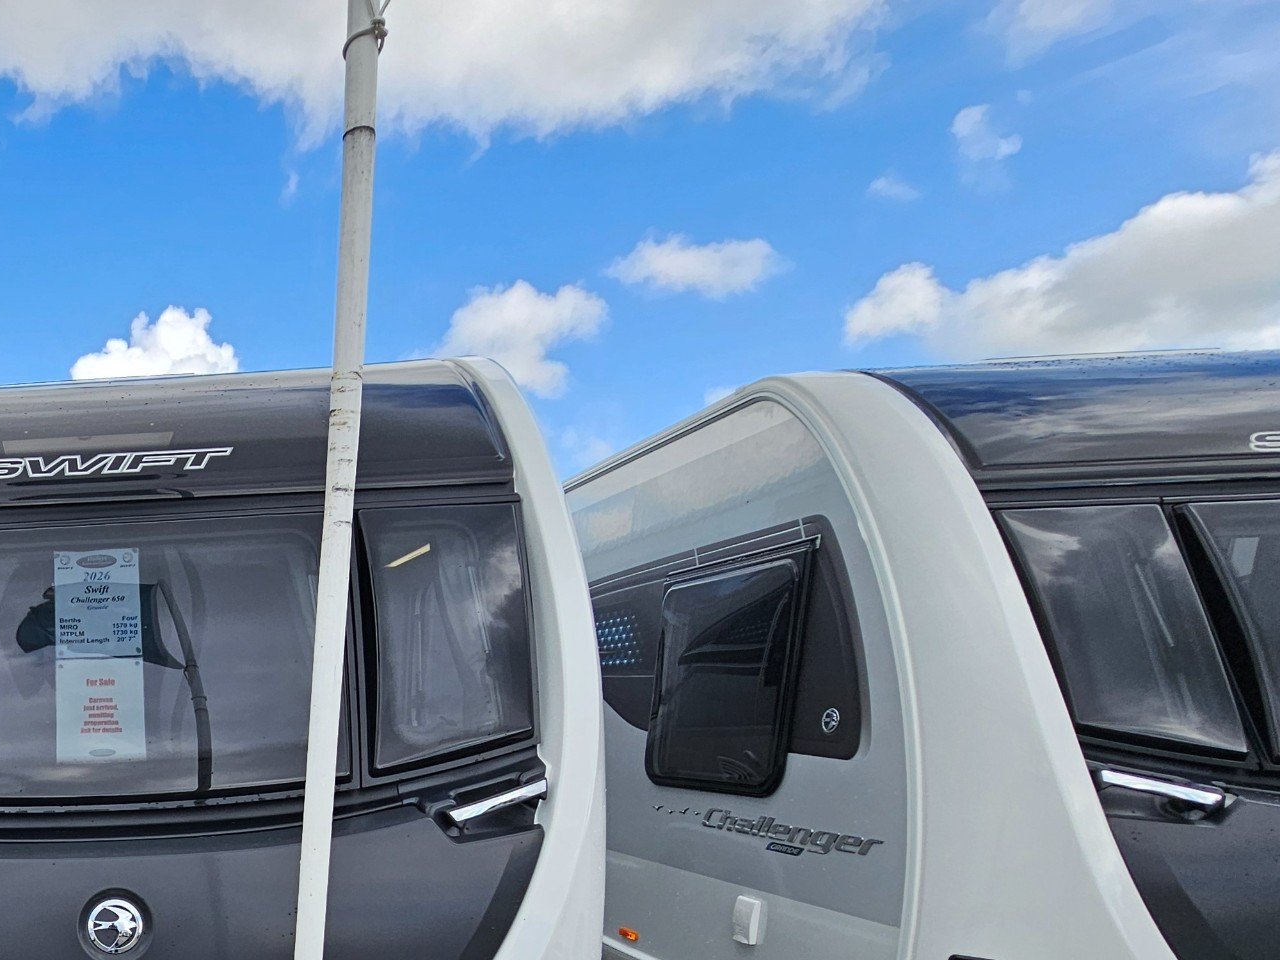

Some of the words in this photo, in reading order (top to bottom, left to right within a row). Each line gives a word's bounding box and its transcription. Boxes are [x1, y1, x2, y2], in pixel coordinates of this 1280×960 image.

[83, 571, 111, 581] 2026
[84, 585, 110, 595] Swift
[70, 596, 110, 604] Challenger
[86, 678, 98, 687] For
[99, 678, 116, 686] Sale
[701, 807, 884, 856] Challenger
